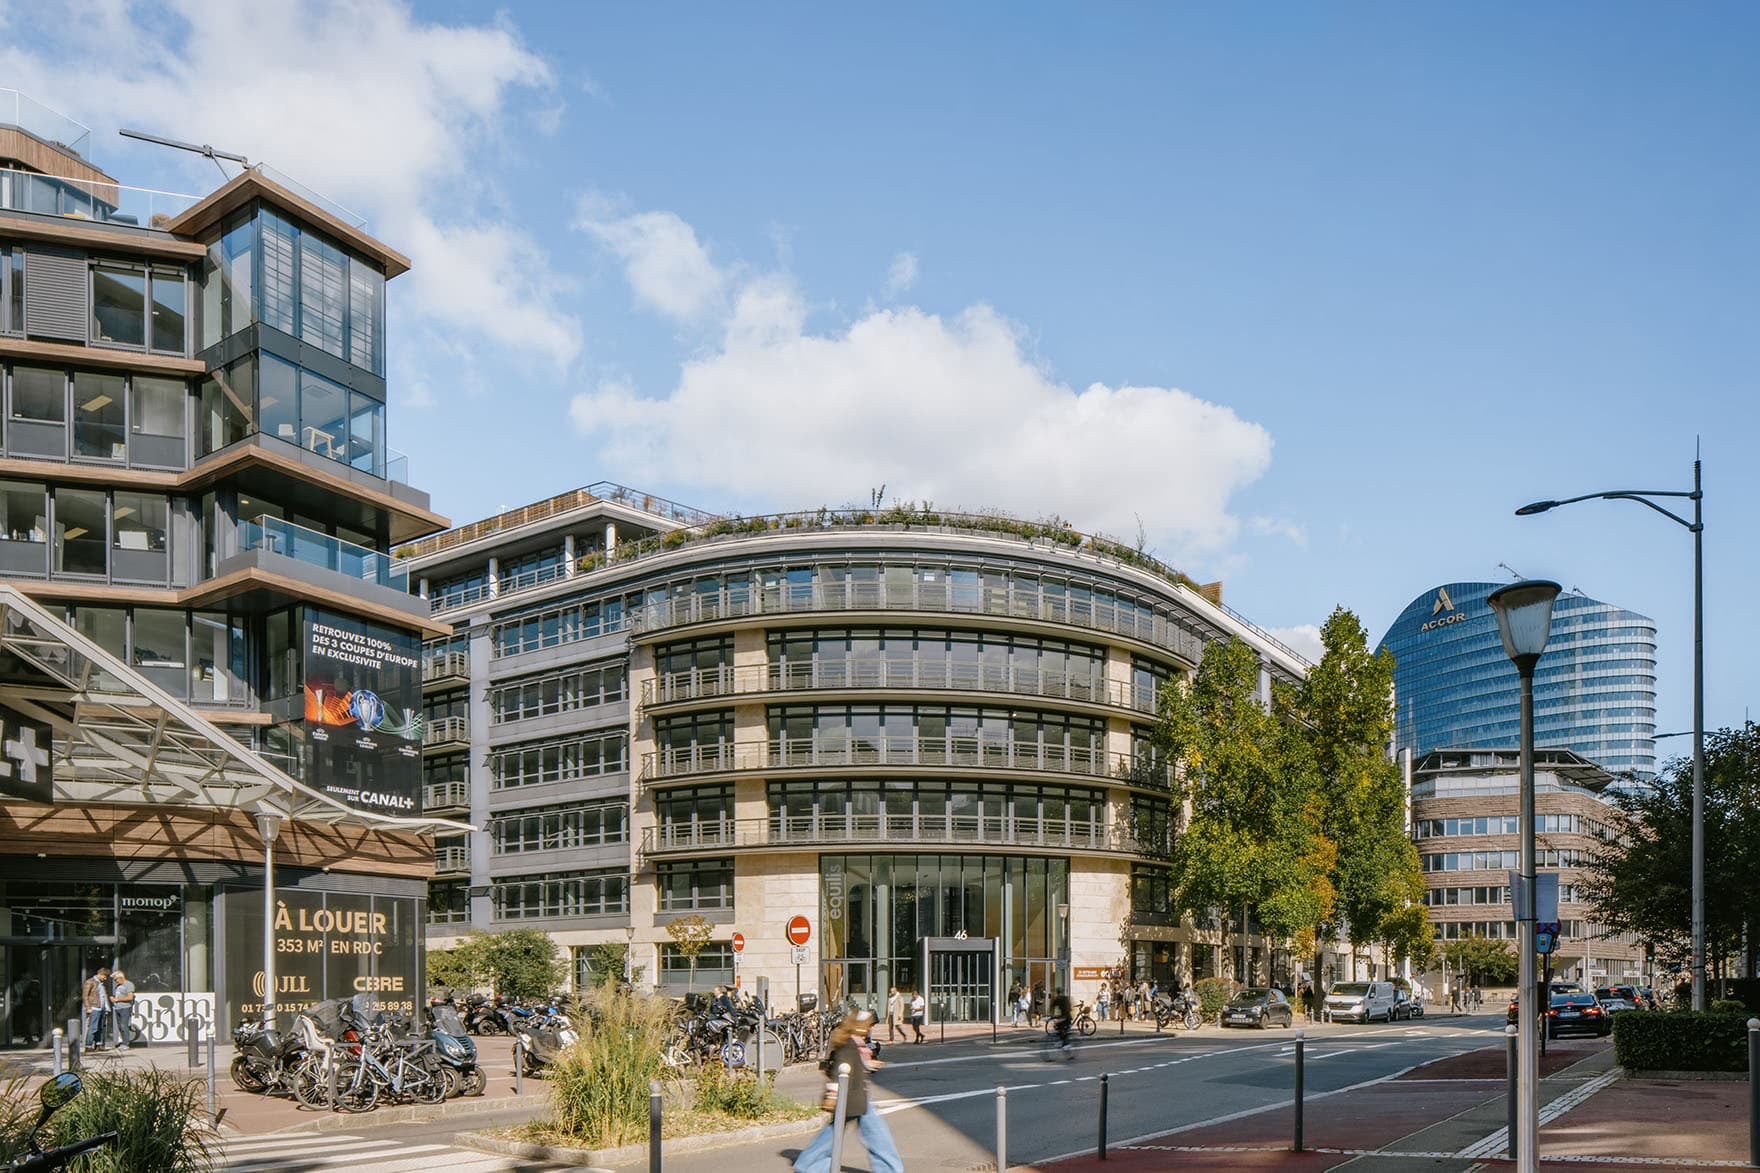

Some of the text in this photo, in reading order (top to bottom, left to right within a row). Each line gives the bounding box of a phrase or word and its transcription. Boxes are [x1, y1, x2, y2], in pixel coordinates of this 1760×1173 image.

[1421, 613, 1465, 632] ACCOR
[312, 623, 392, 651] RETROUVEZ 100%
[312, 634, 419, 669] DES 3 COUPES D'EUROPE
[312, 645, 382, 670] EN EXCLUSIVITE
[360, 790, 415, 809] CANAL+
[274, 900, 387, 935] À LOUER
[954, 929, 968, 940] 46
[277, 939, 304, 953] 353
[331, 941, 350, 955] EN
[353, 941, 384, 956] RDC
[279, 975, 311, 993] JLL
[353, 976, 404, 992] CBRE
[241, 1003, 254, 1013] 01
[284, 1003, 297, 1012] 15
[387, 1001, 400, 1011] 89
